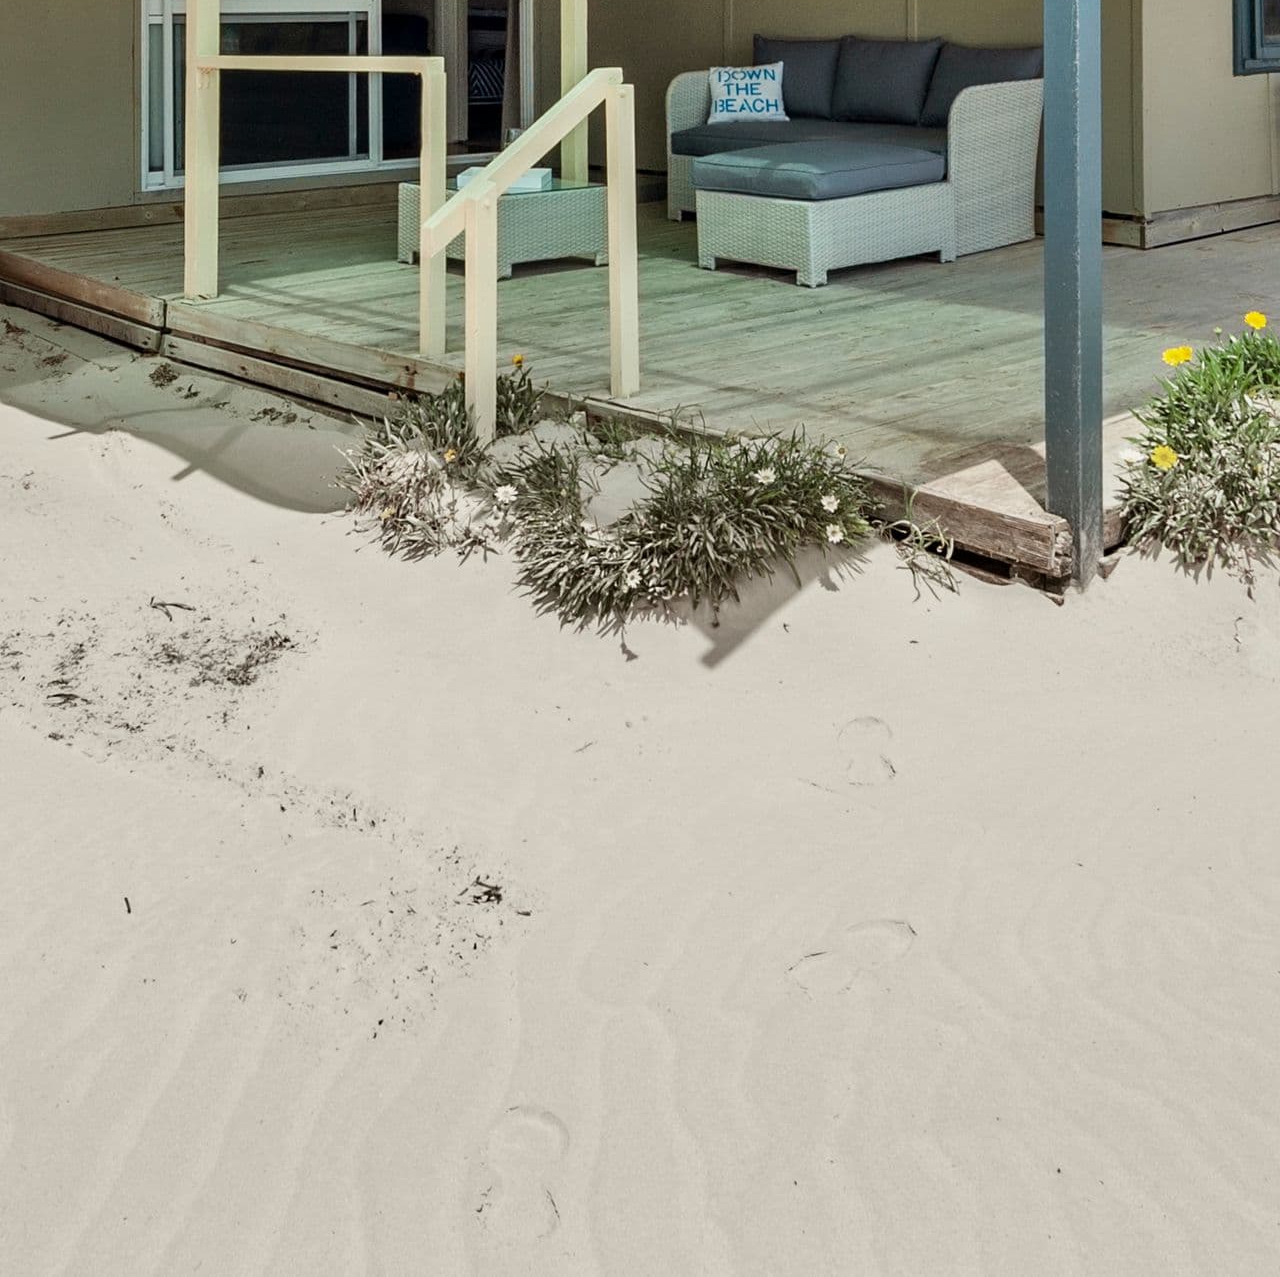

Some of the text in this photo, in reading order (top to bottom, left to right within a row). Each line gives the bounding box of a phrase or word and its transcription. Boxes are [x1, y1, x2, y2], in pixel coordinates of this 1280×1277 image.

[718, 68, 775, 83] DOWN
[723, 83, 762, 96] THE
[714, 98, 778, 113] BEACH
